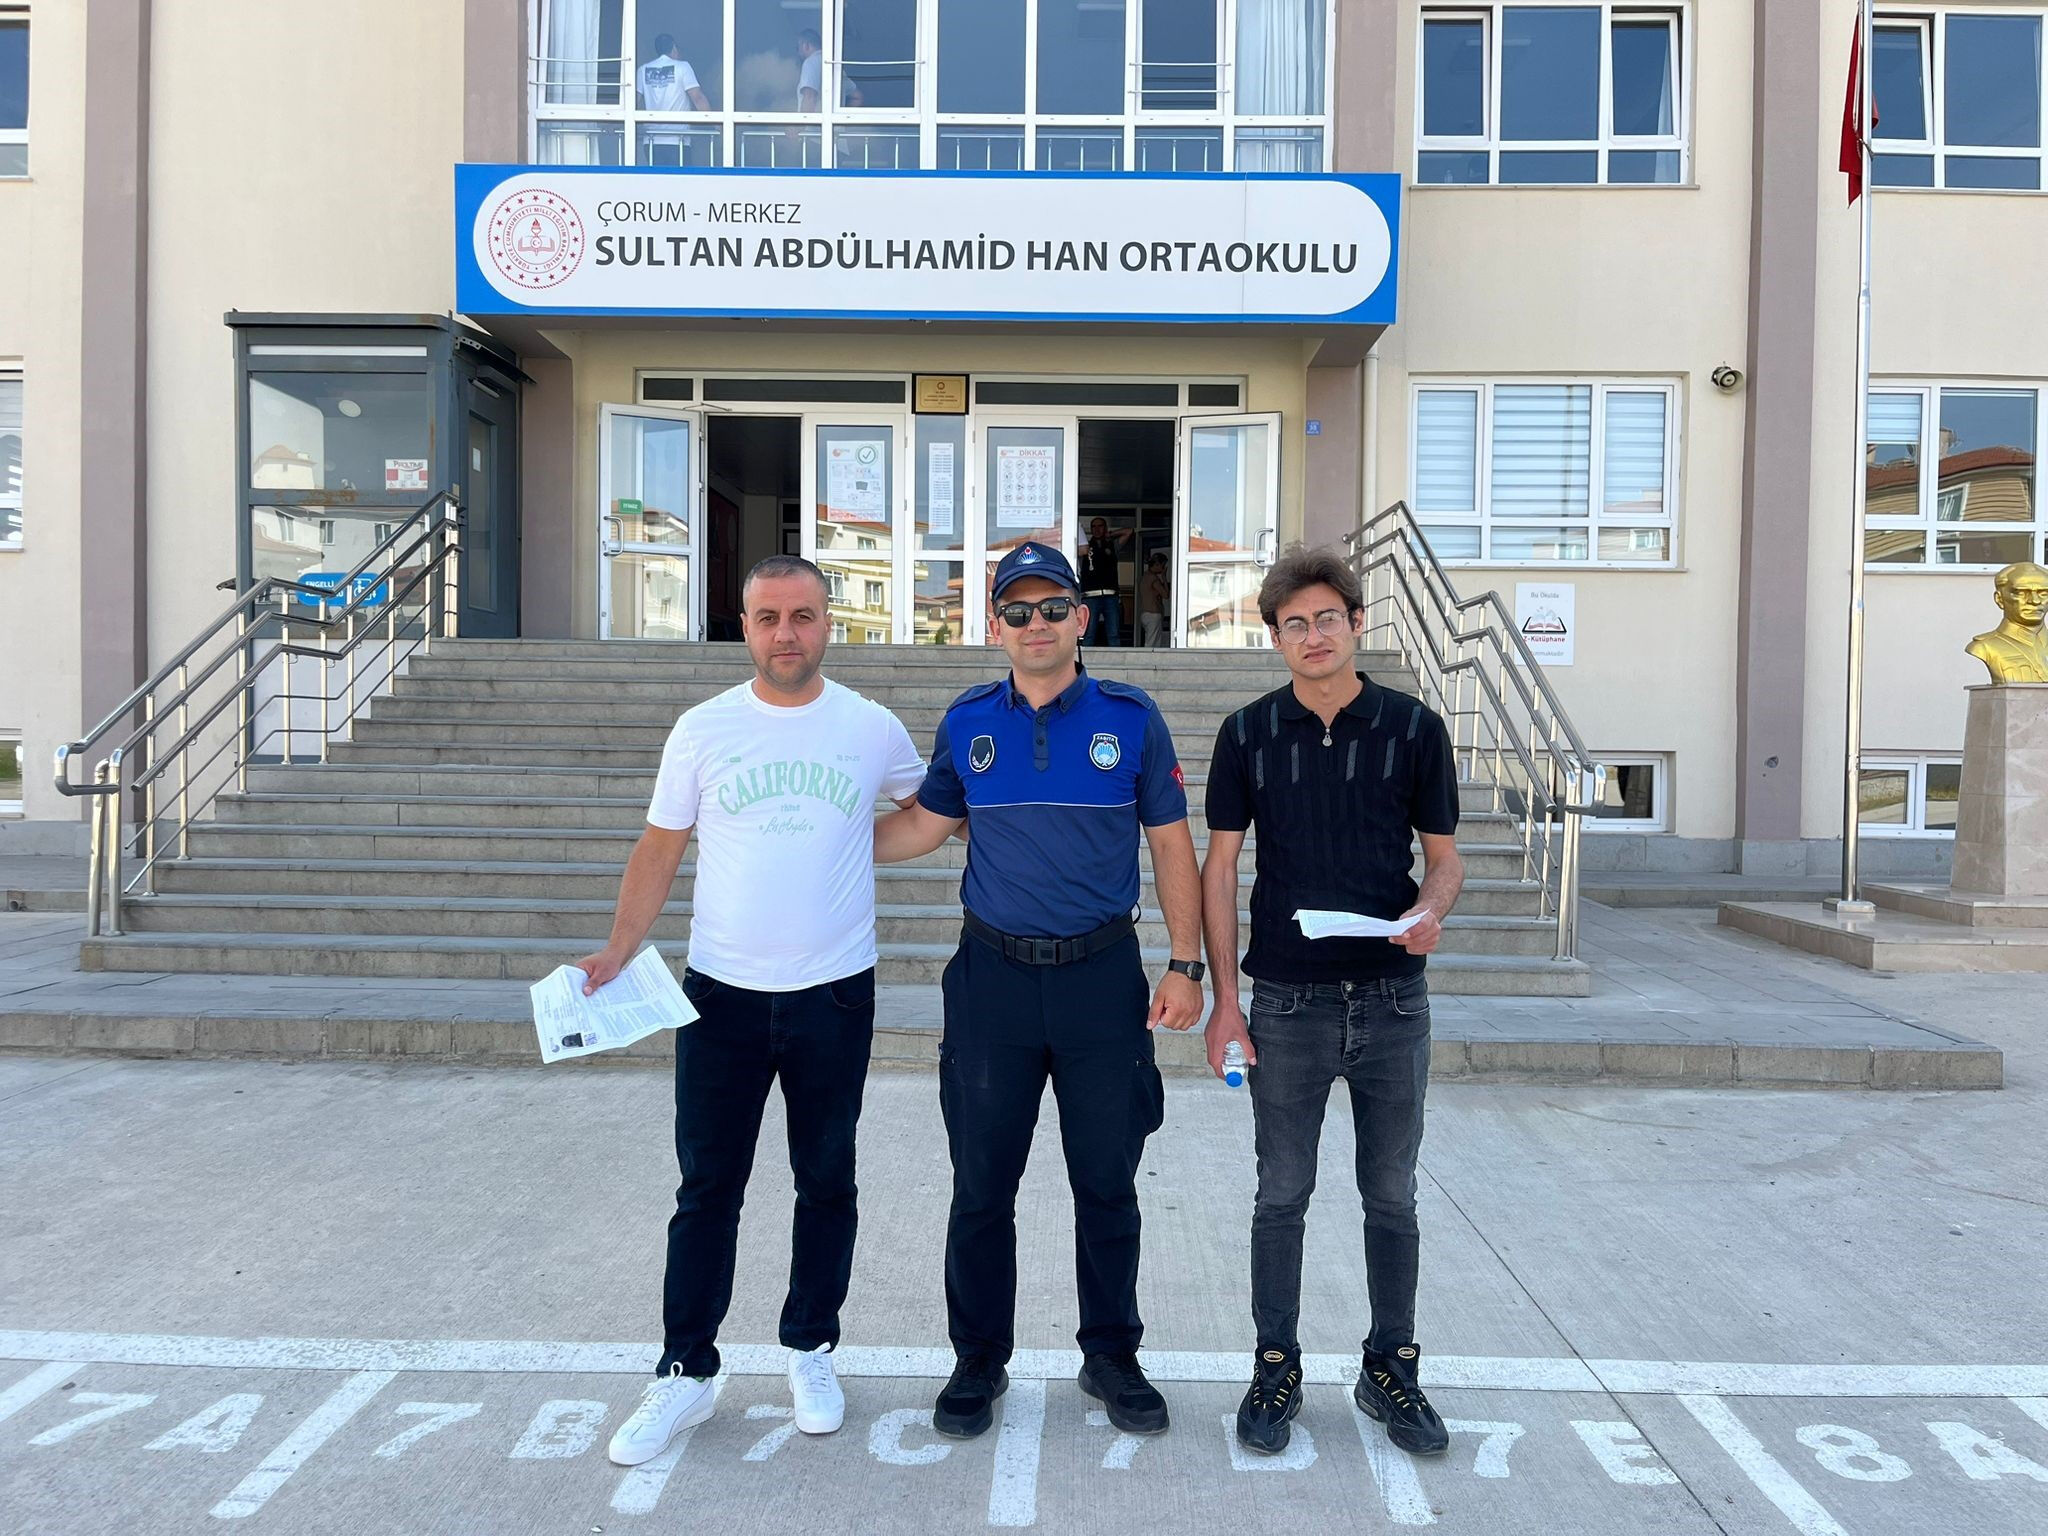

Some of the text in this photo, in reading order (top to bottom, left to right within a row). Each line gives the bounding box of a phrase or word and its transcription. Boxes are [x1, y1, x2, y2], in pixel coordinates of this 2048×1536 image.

[597, 201, 686, 228] ÇORUM
[708, 202, 802, 224] MERKEZ
[595, 231, 1357, 274] SULTAN ABDÜLHAMİD HAN ORTAOKULU
[1019, 448, 1047, 457] DİKKAT
[1523, 635, 1566, 644] Z-Kütüphane
[718, 761, 861, 818] CALIFORNIA
